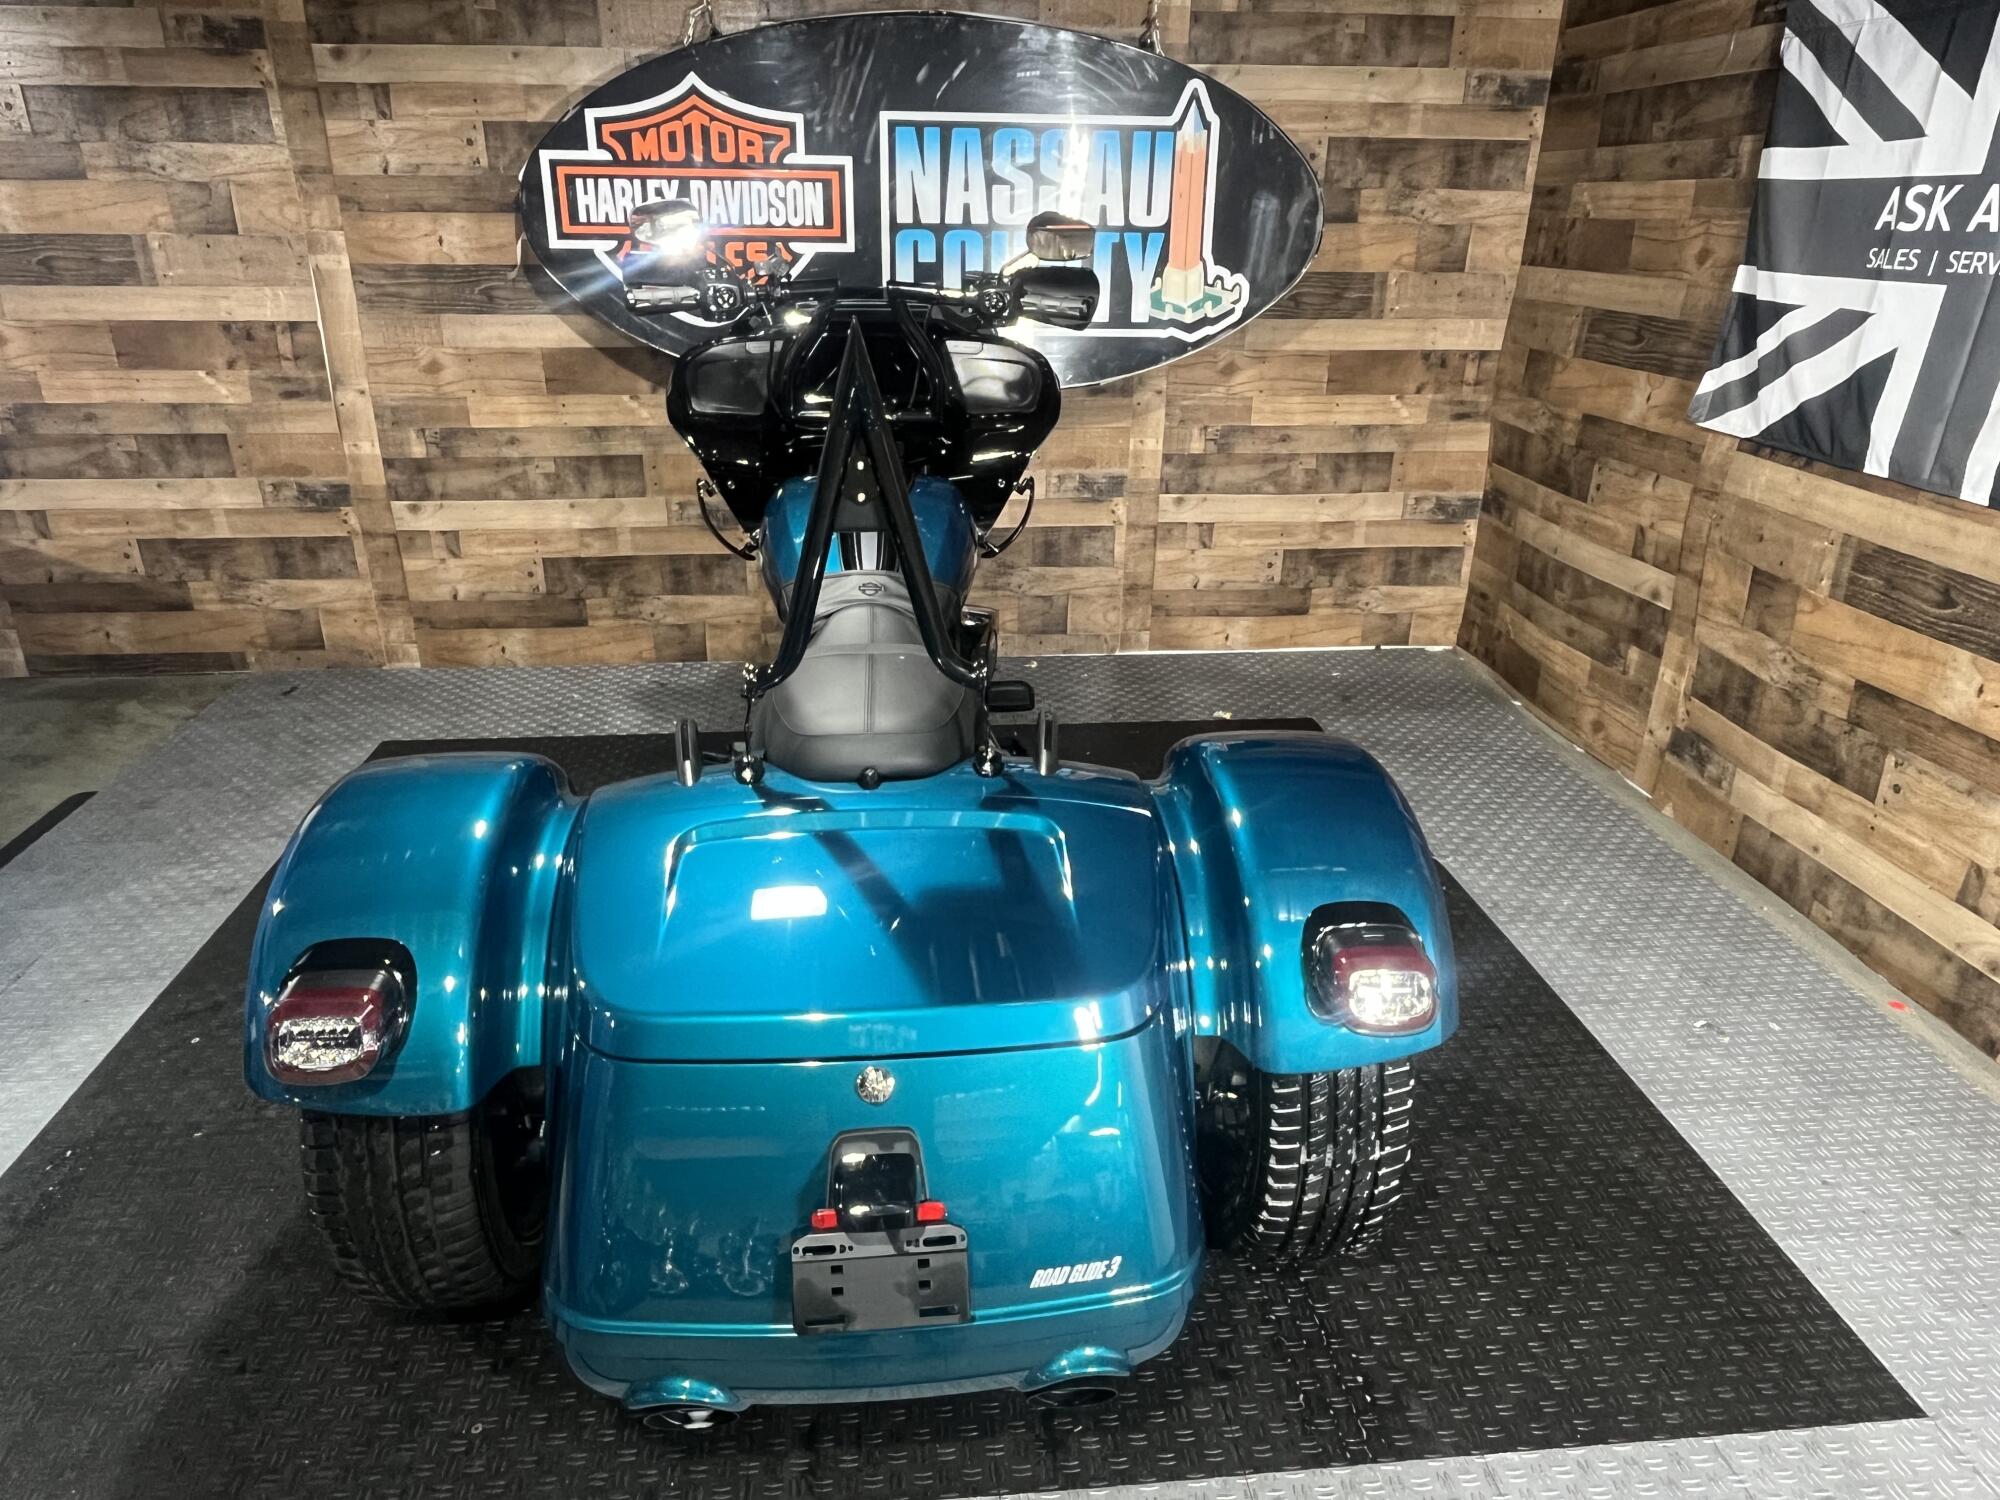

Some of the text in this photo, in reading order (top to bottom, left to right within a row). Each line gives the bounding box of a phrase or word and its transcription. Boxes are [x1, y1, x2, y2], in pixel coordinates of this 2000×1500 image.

[631, 109, 764, 164] MOTOR
[895, 126, 1175, 227] NASSAU
[1874, 184, 1965, 232] ASK
[895, 228, 1165, 323] COTY
[1866, 247, 1921, 271] SALES
[1945, 250, 2000, 275] SERV
[1030, 1255, 1122, 1288] ROAD GLIDE 3
